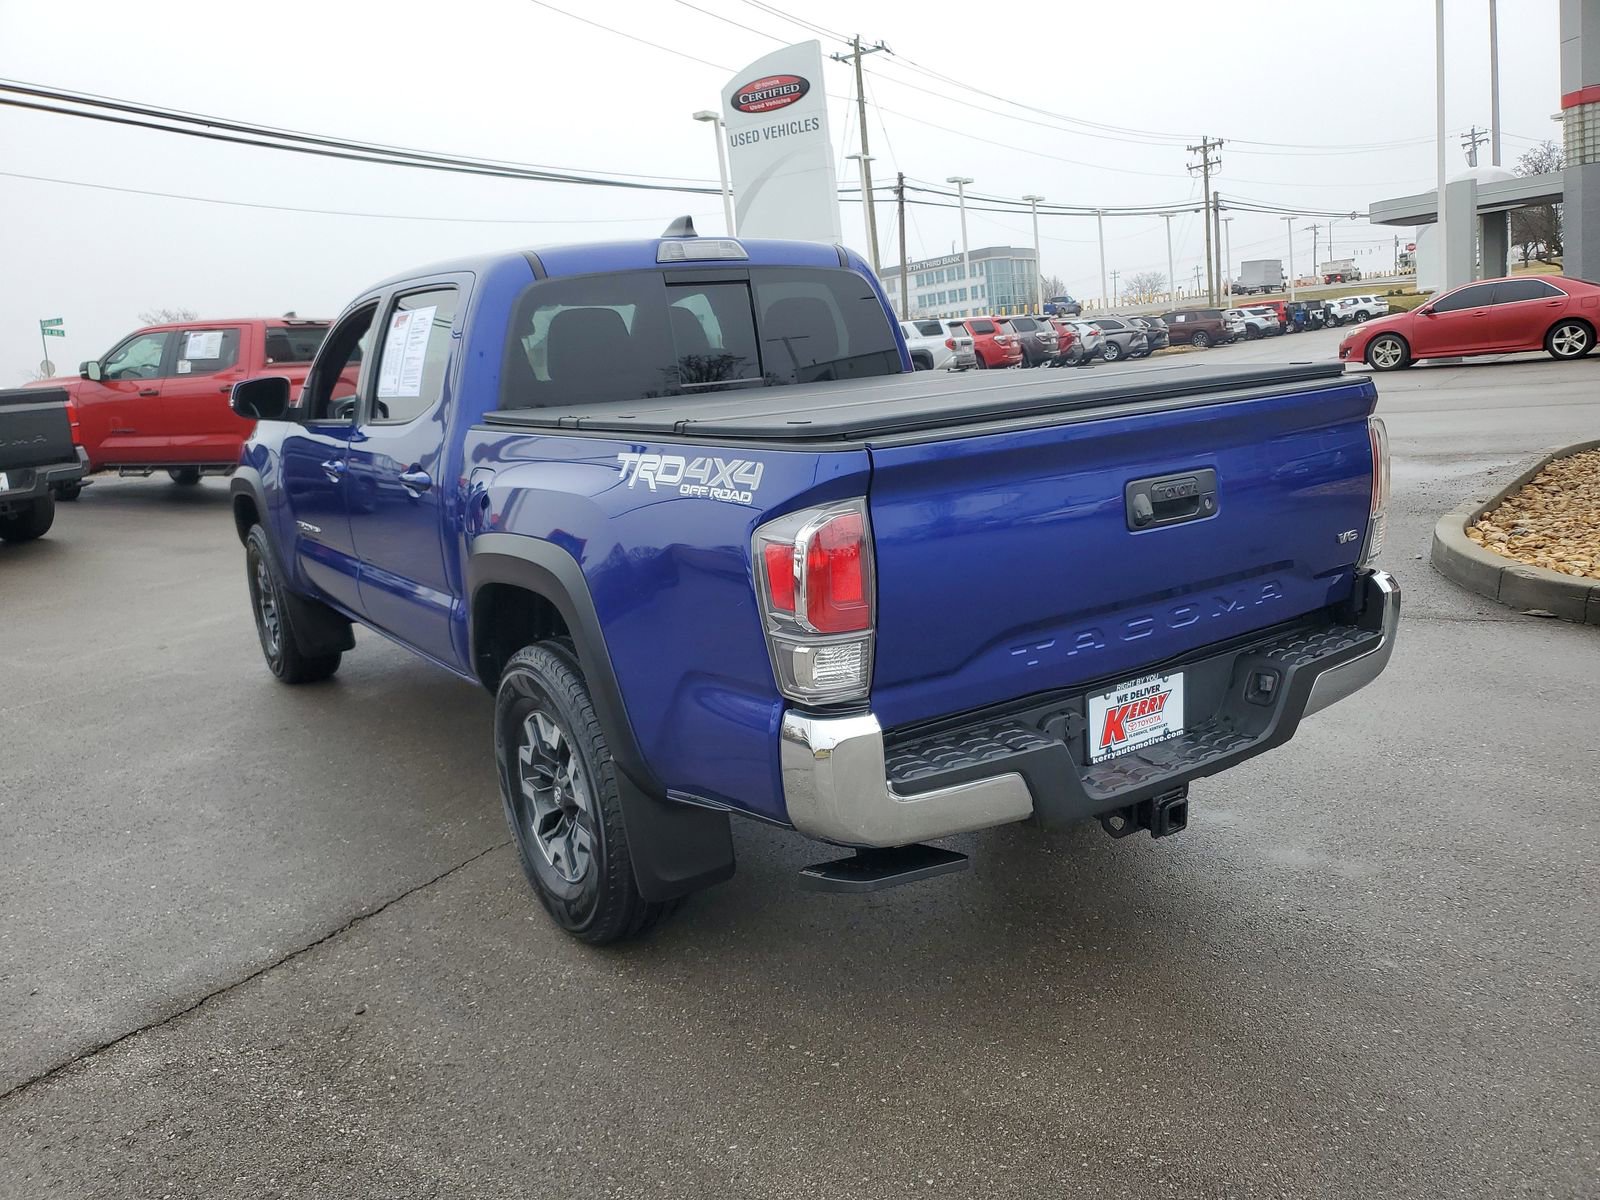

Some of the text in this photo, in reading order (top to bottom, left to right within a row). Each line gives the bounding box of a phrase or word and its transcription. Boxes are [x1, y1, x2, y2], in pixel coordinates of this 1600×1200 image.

[739, 84, 800, 104] CERTIFIED
[749, 97, 792, 111] Used Vehicles
[731, 117, 820, 147] USED VEHICLES
[617, 452, 686, 492] TRD
[679, 484, 753, 504] OFF ROAD
[1158, 482, 1198, 499] TOYOTA
[1337, 528, 1359, 544] V6
[1010, 579, 1283, 665] TACOMA
[1146, 673, 1159, 681] YOU
[1117, 684, 1161, 704] WE DELIVER
[1101, 691, 1171, 748] KERRY
[1137, 715, 1161, 727] TOYOTA
[1092, 729, 1184, 764] kerryautomotive.com
